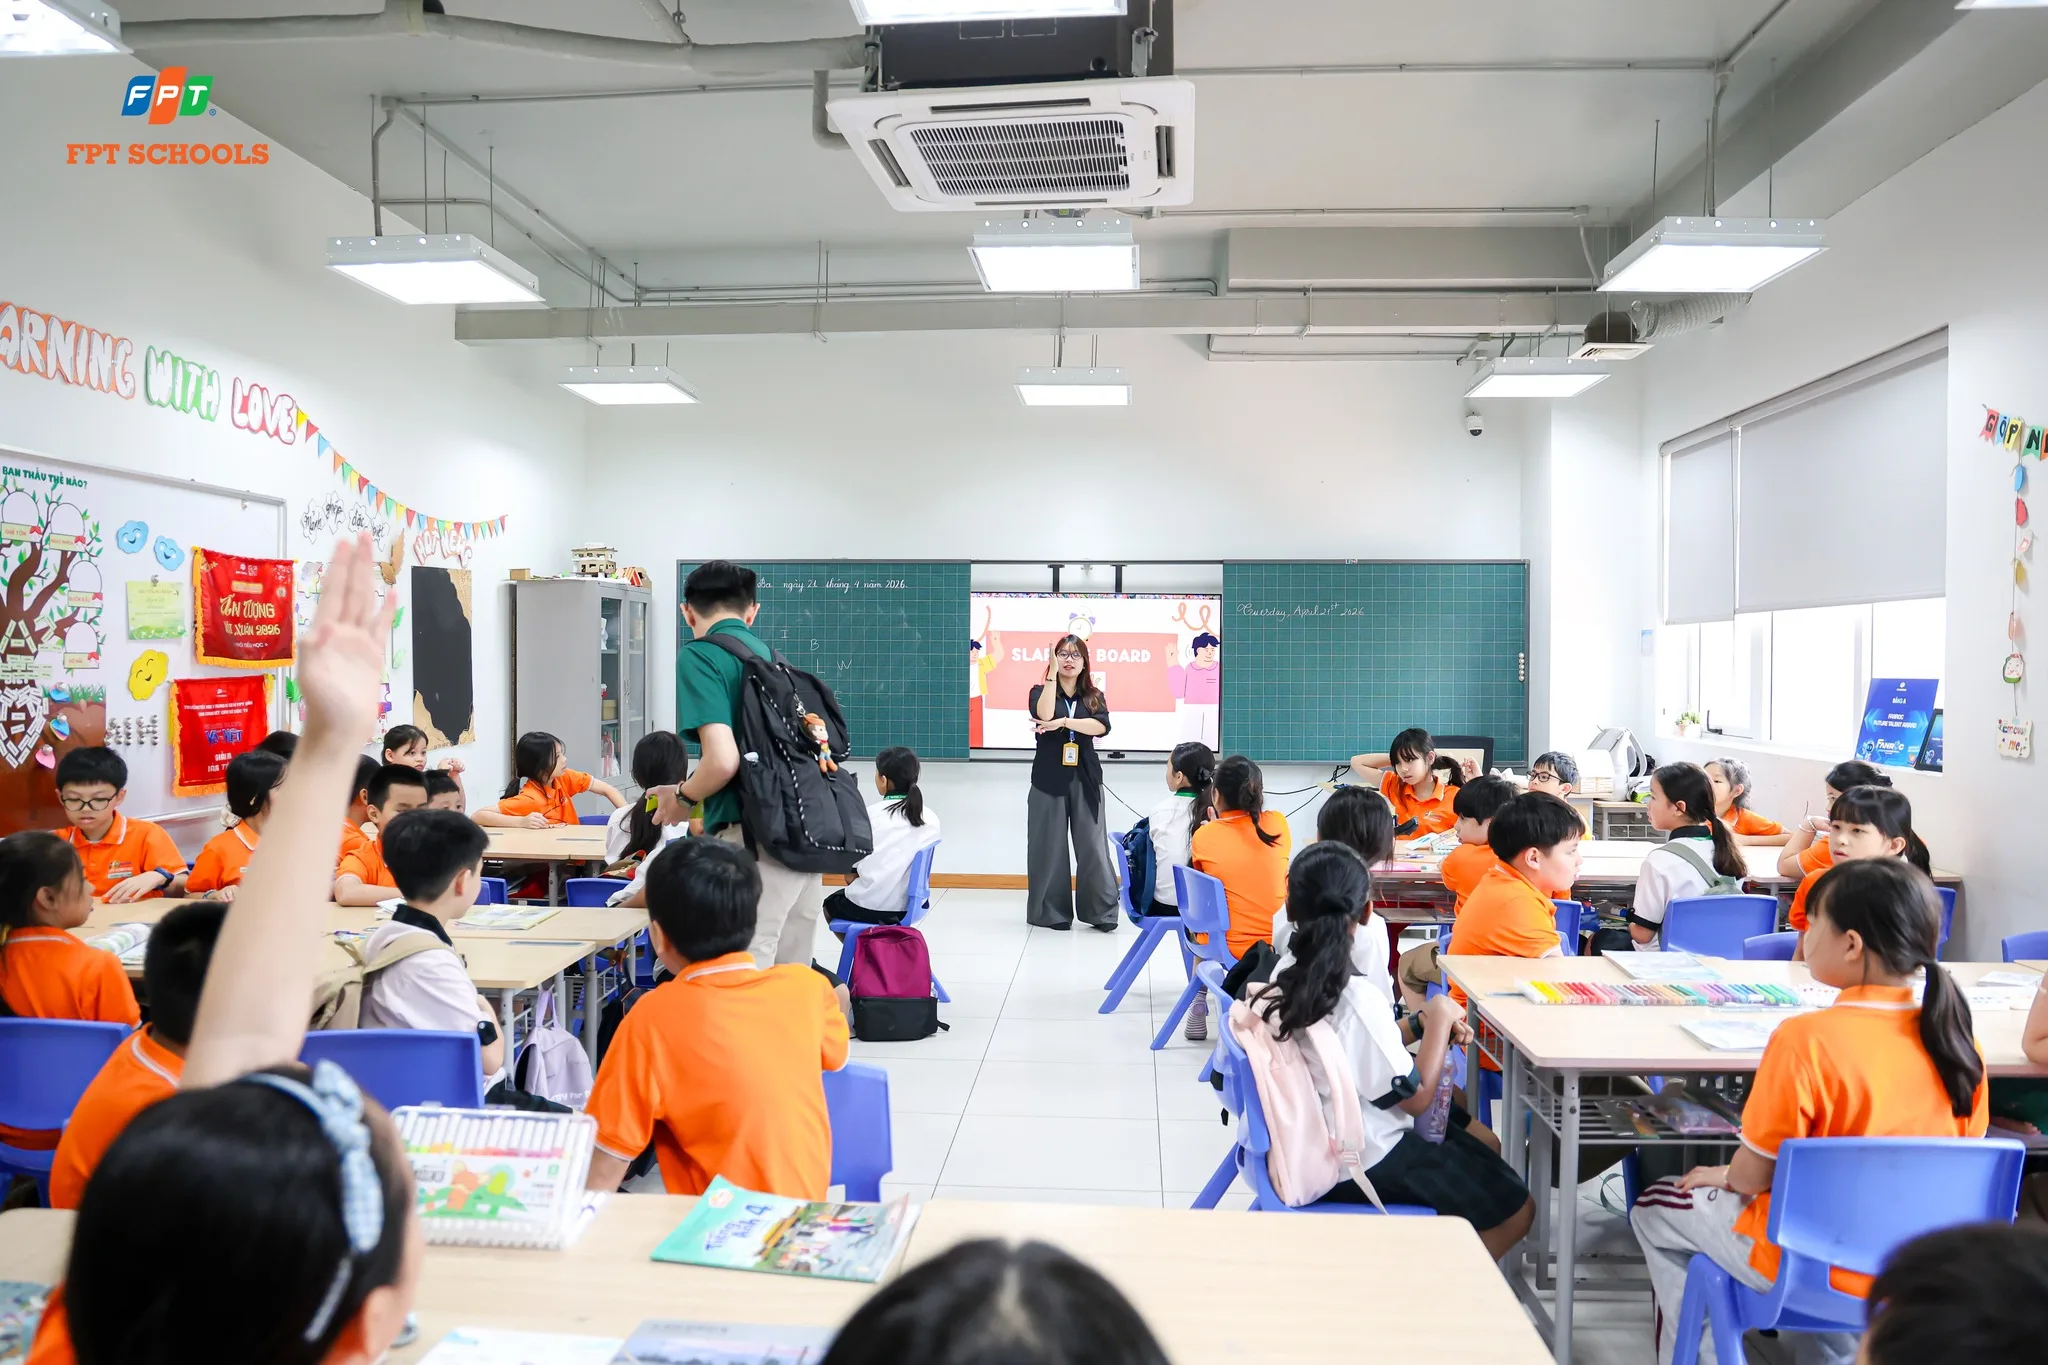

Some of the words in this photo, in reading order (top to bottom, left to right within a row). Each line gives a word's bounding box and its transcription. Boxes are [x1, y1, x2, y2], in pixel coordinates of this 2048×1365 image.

[145, 345, 221, 422] WITH
[783, 579, 804, 593] ngày
[825, 578, 850, 594] tháng
[864, 579, 883, 588] năm
[1293, 604, 1319, 619] April
[1096, 648, 1152, 663] BOARD
